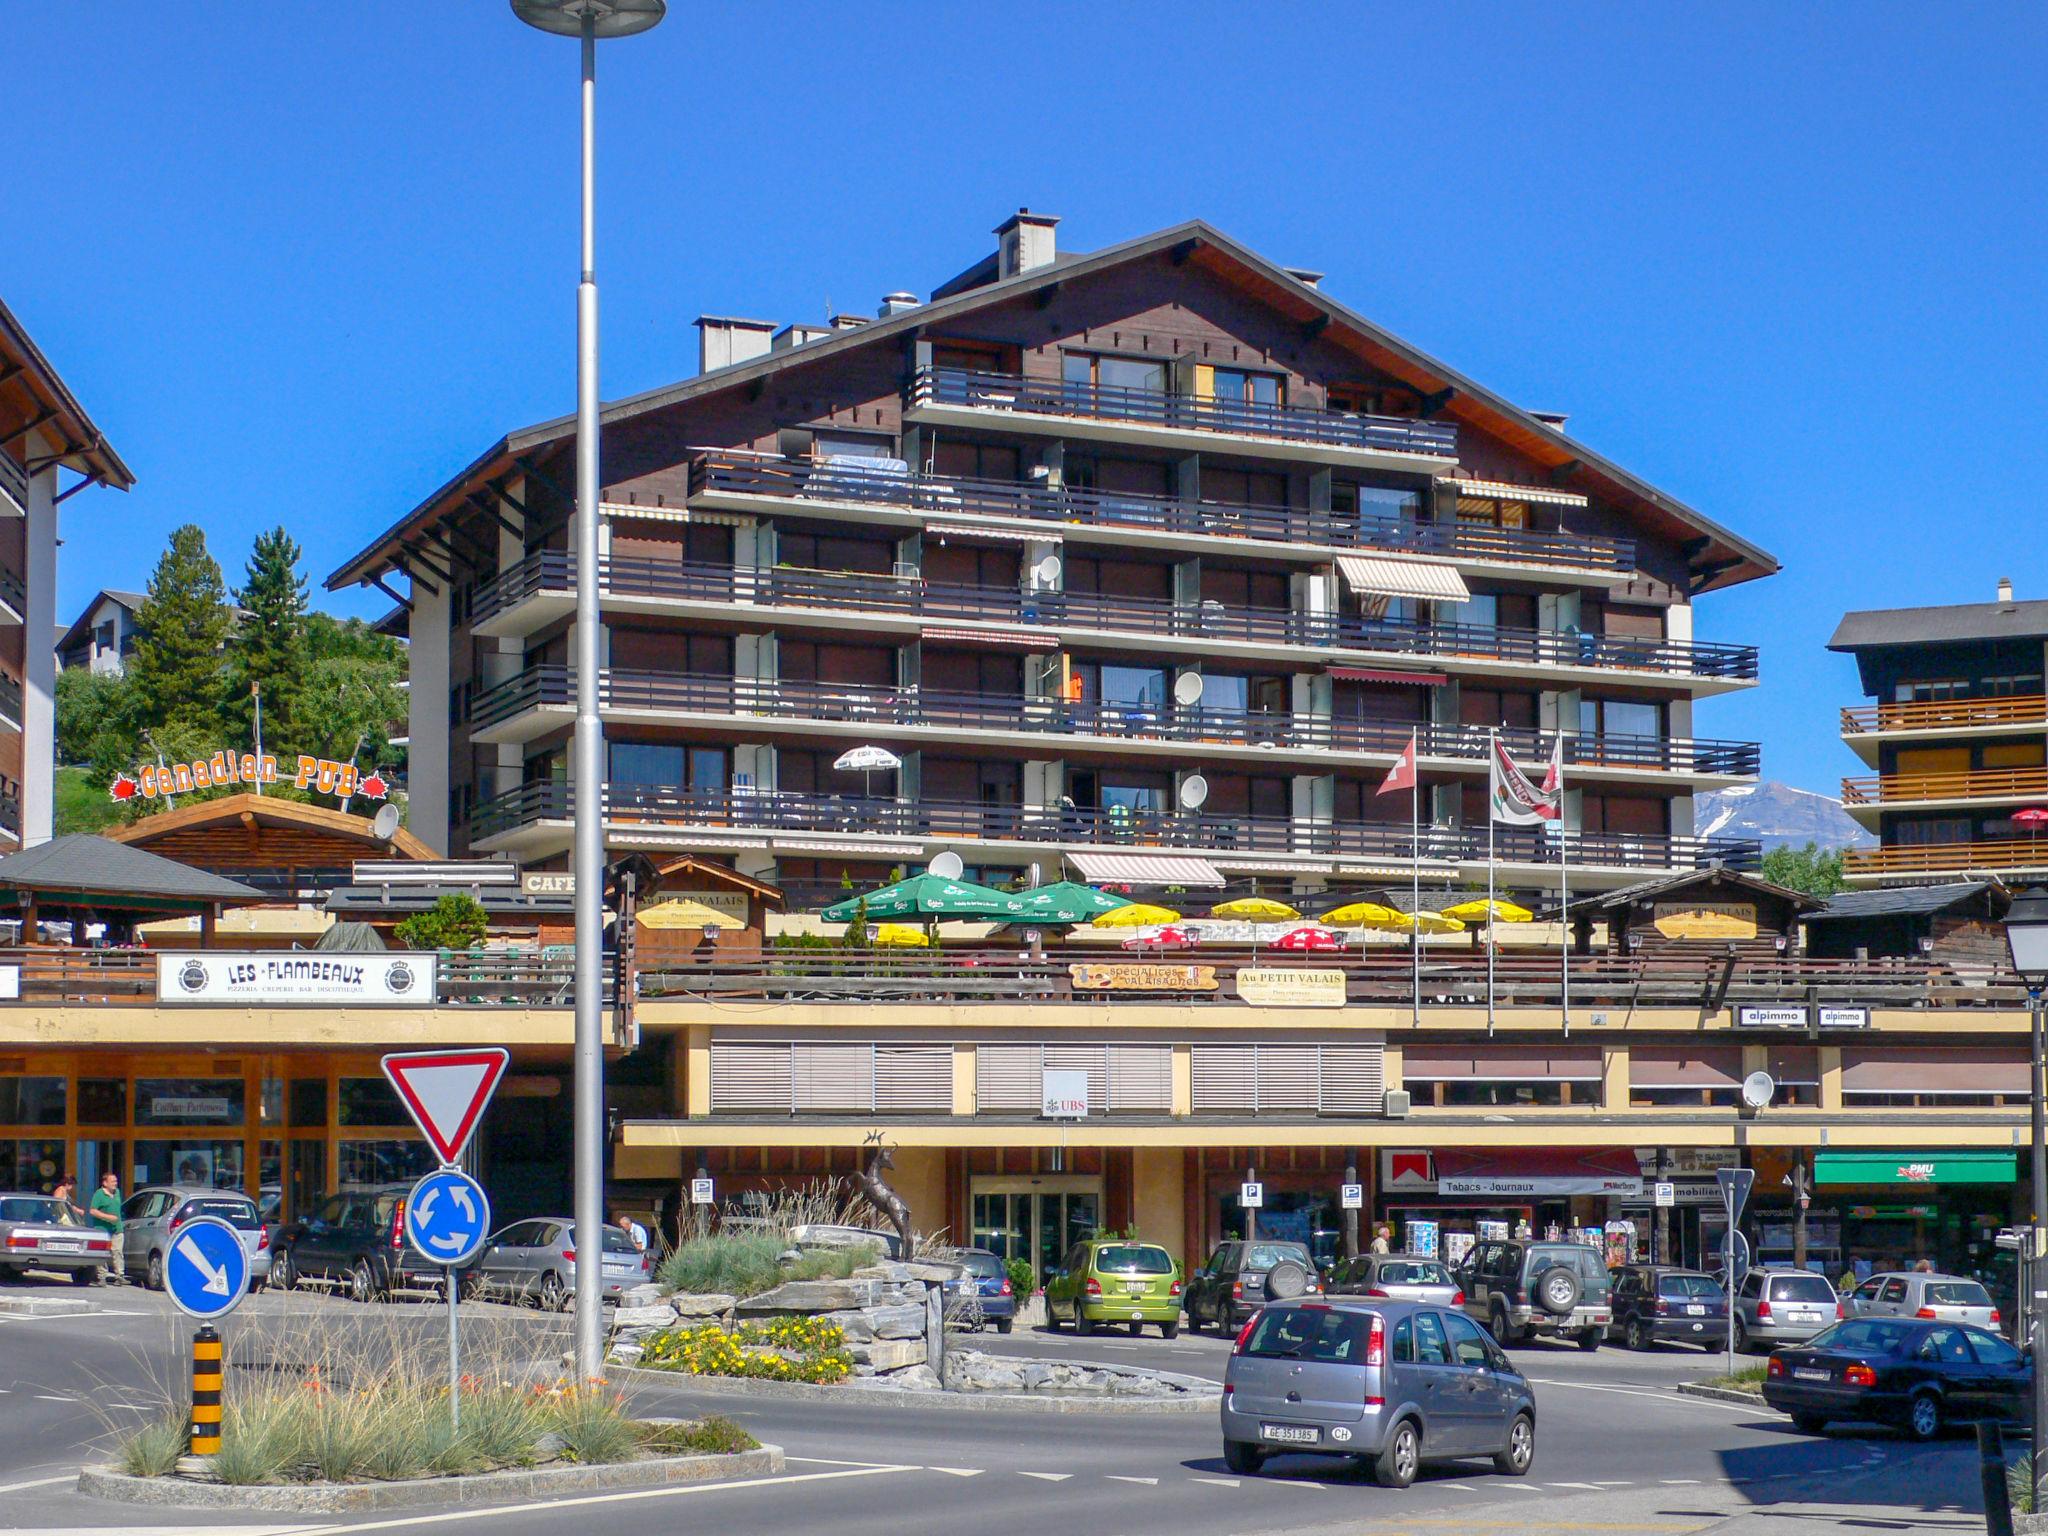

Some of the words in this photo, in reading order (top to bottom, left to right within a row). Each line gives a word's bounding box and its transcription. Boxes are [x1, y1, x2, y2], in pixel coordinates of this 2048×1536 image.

[139, 750, 277, 798] Canadian
[658, 896, 698, 905] PETIT
[701, 896, 744, 906] VALAIS
[1711, 907, 1752, 916] VALAIS
[228, 964, 256, 984] LES
[268, 961, 364, 985] FLAMBEAUX
[1241, 973, 1256, 982] Au
[1260, 973, 1296, 983] PETIT
[1298, 974, 1342, 983] VALAIS
[1749, 1010, 1798, 1024] alpimmo
[1825, 1010, 1860, 1024] alpimmo
[1061, 1100, 1085, 1111] UBS
[1909, 1163, 1934, 1174] PMU
[1446, 1182, 1482, 1191] Tabacs
[1489, 1182, 1534, 1192] Journaux
[1270, 1428, 1281, 1438] GE
[1334, 1429, 1348, 1439] CH
